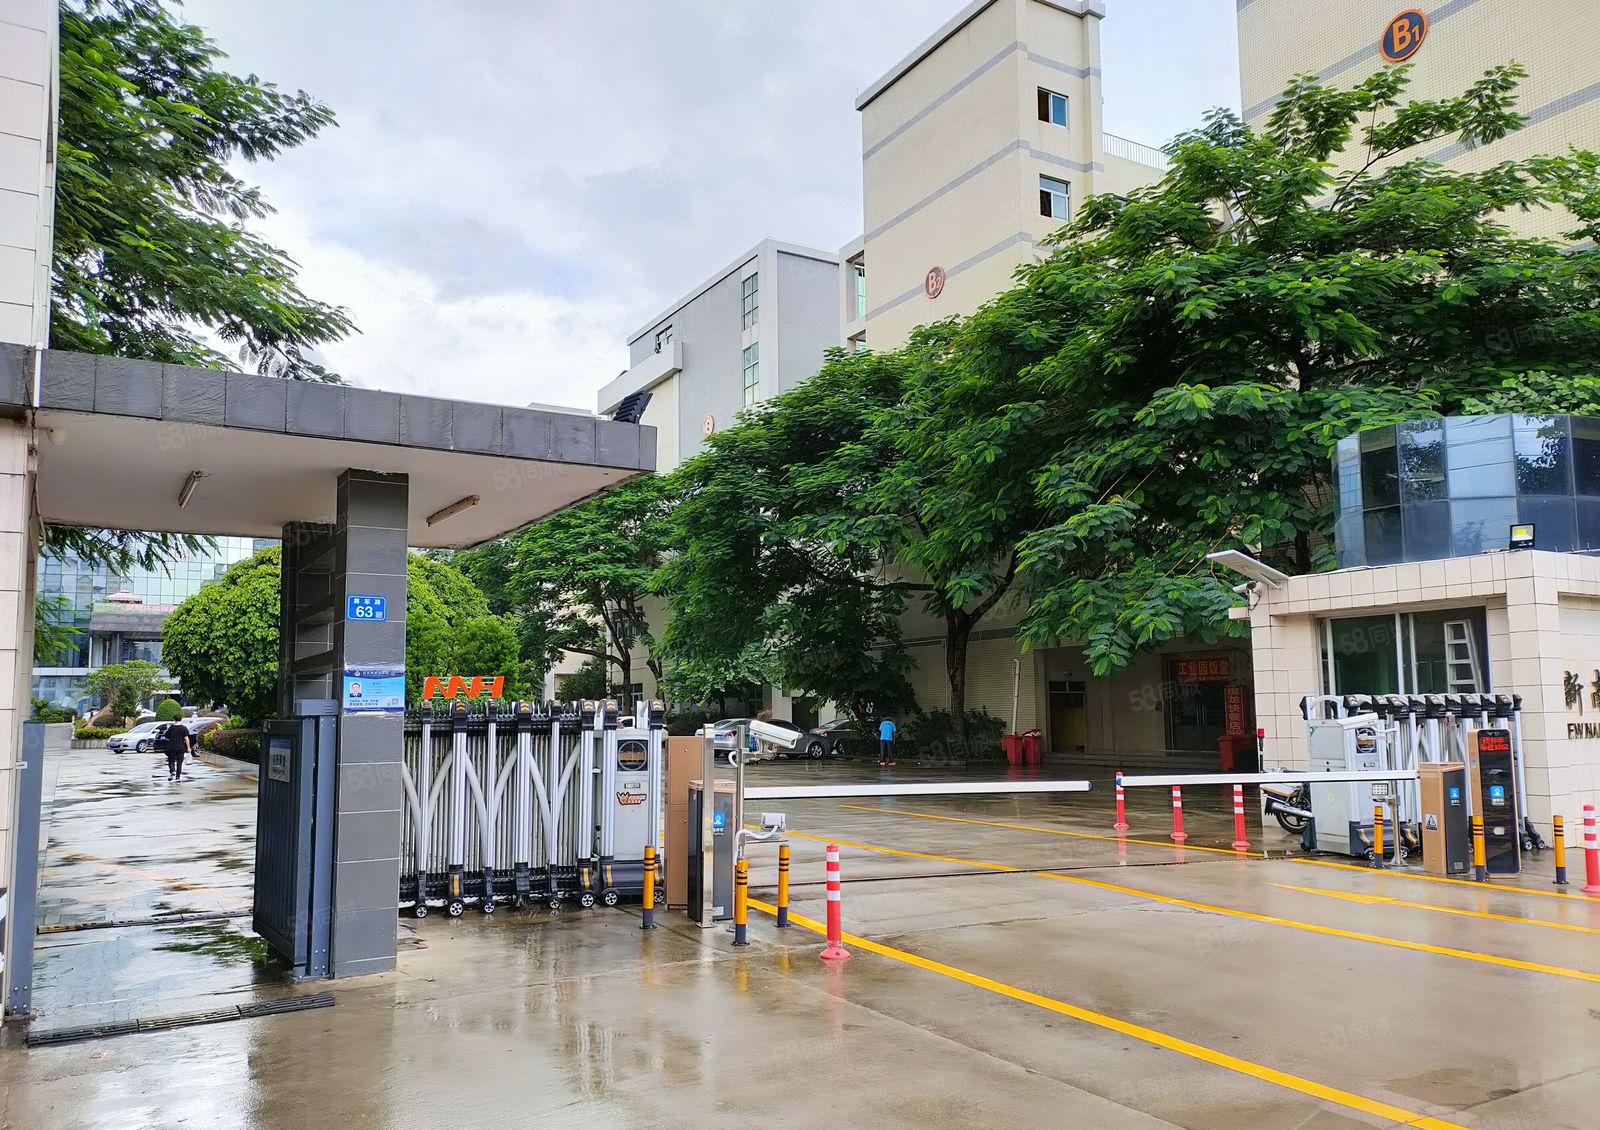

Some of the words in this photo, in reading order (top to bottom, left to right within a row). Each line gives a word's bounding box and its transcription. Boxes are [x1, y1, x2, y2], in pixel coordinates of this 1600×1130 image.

[1393, 18, 1419, 53] B1
[929, 272, 941, 293] B2
[355, 606, 373, 618] 63
